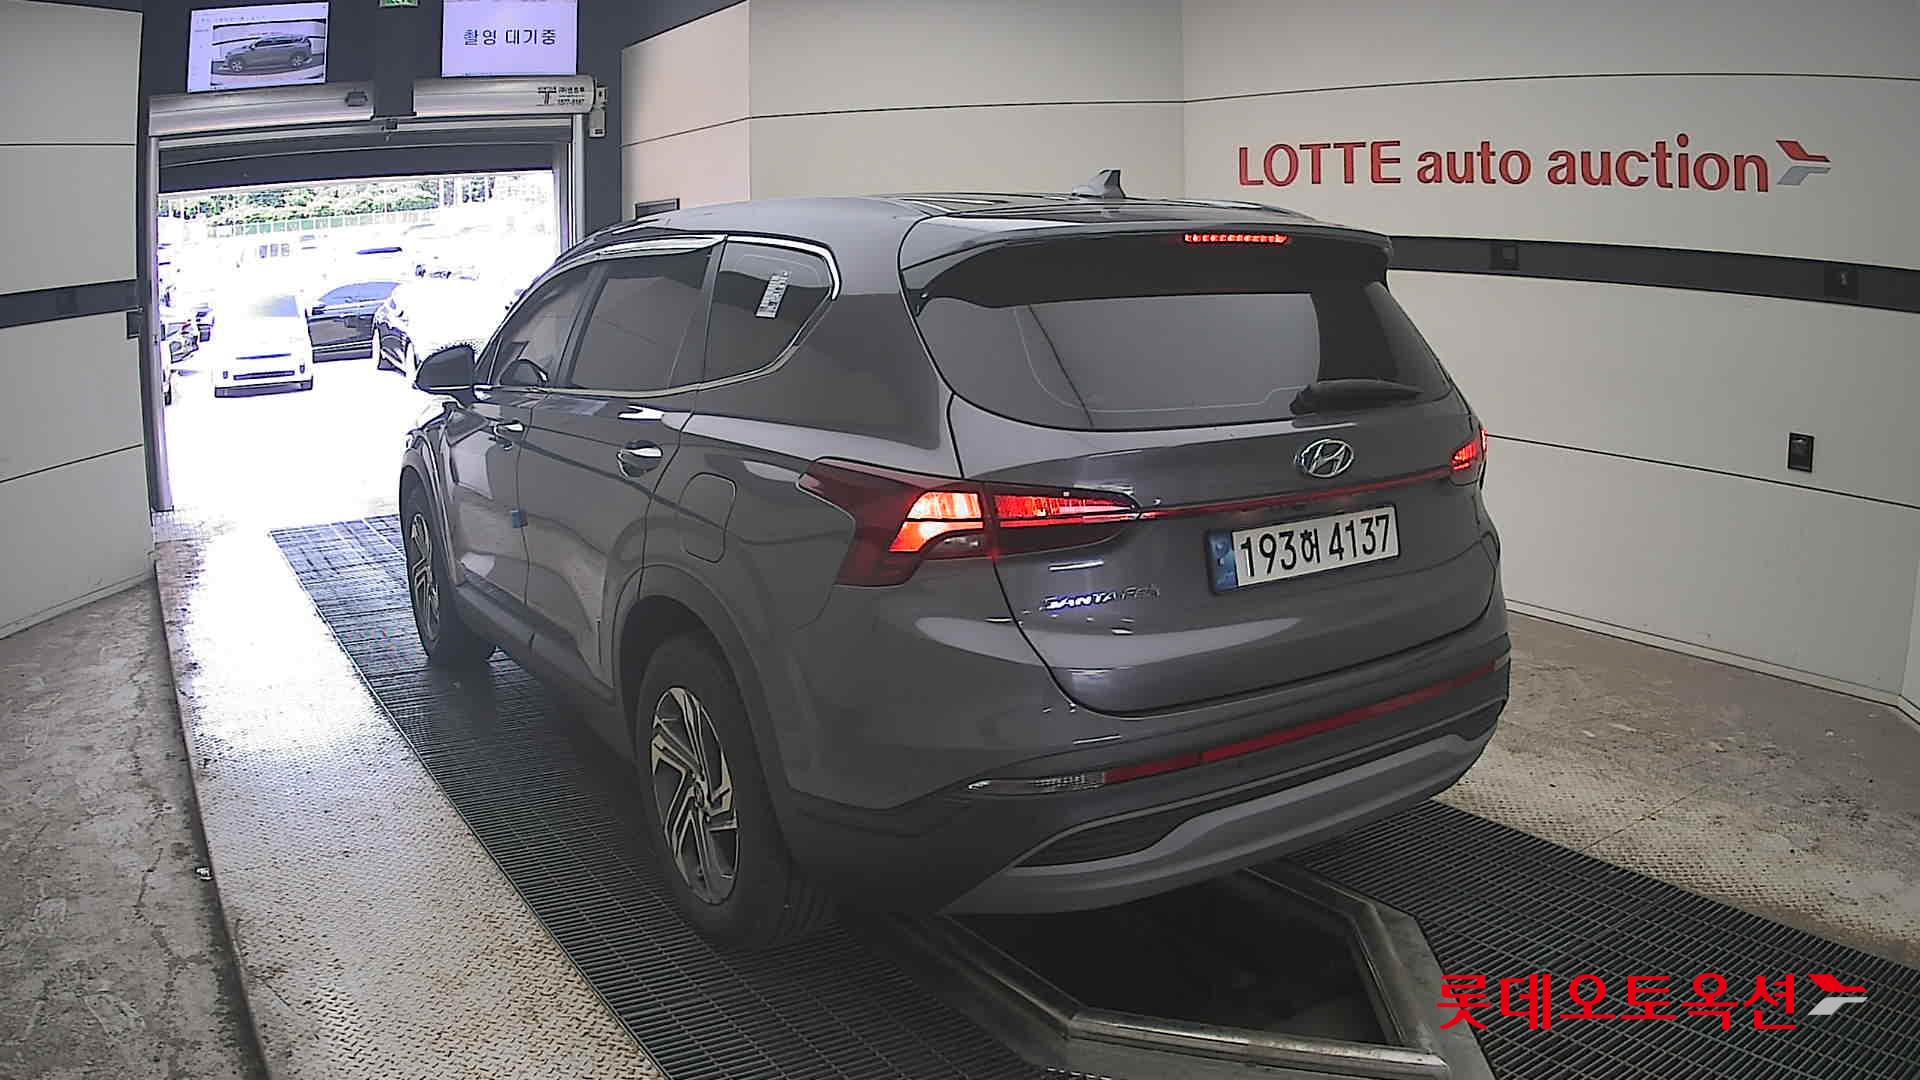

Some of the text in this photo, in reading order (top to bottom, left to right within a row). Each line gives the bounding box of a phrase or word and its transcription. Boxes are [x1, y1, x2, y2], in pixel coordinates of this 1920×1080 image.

[505, 29, 556, 46] 대기중
[1238, 133, 1769, 193] LOTTE auto auction
[1240, 530, 1321, 577] 193허
[1329, 514, 1390, 561] 4137
